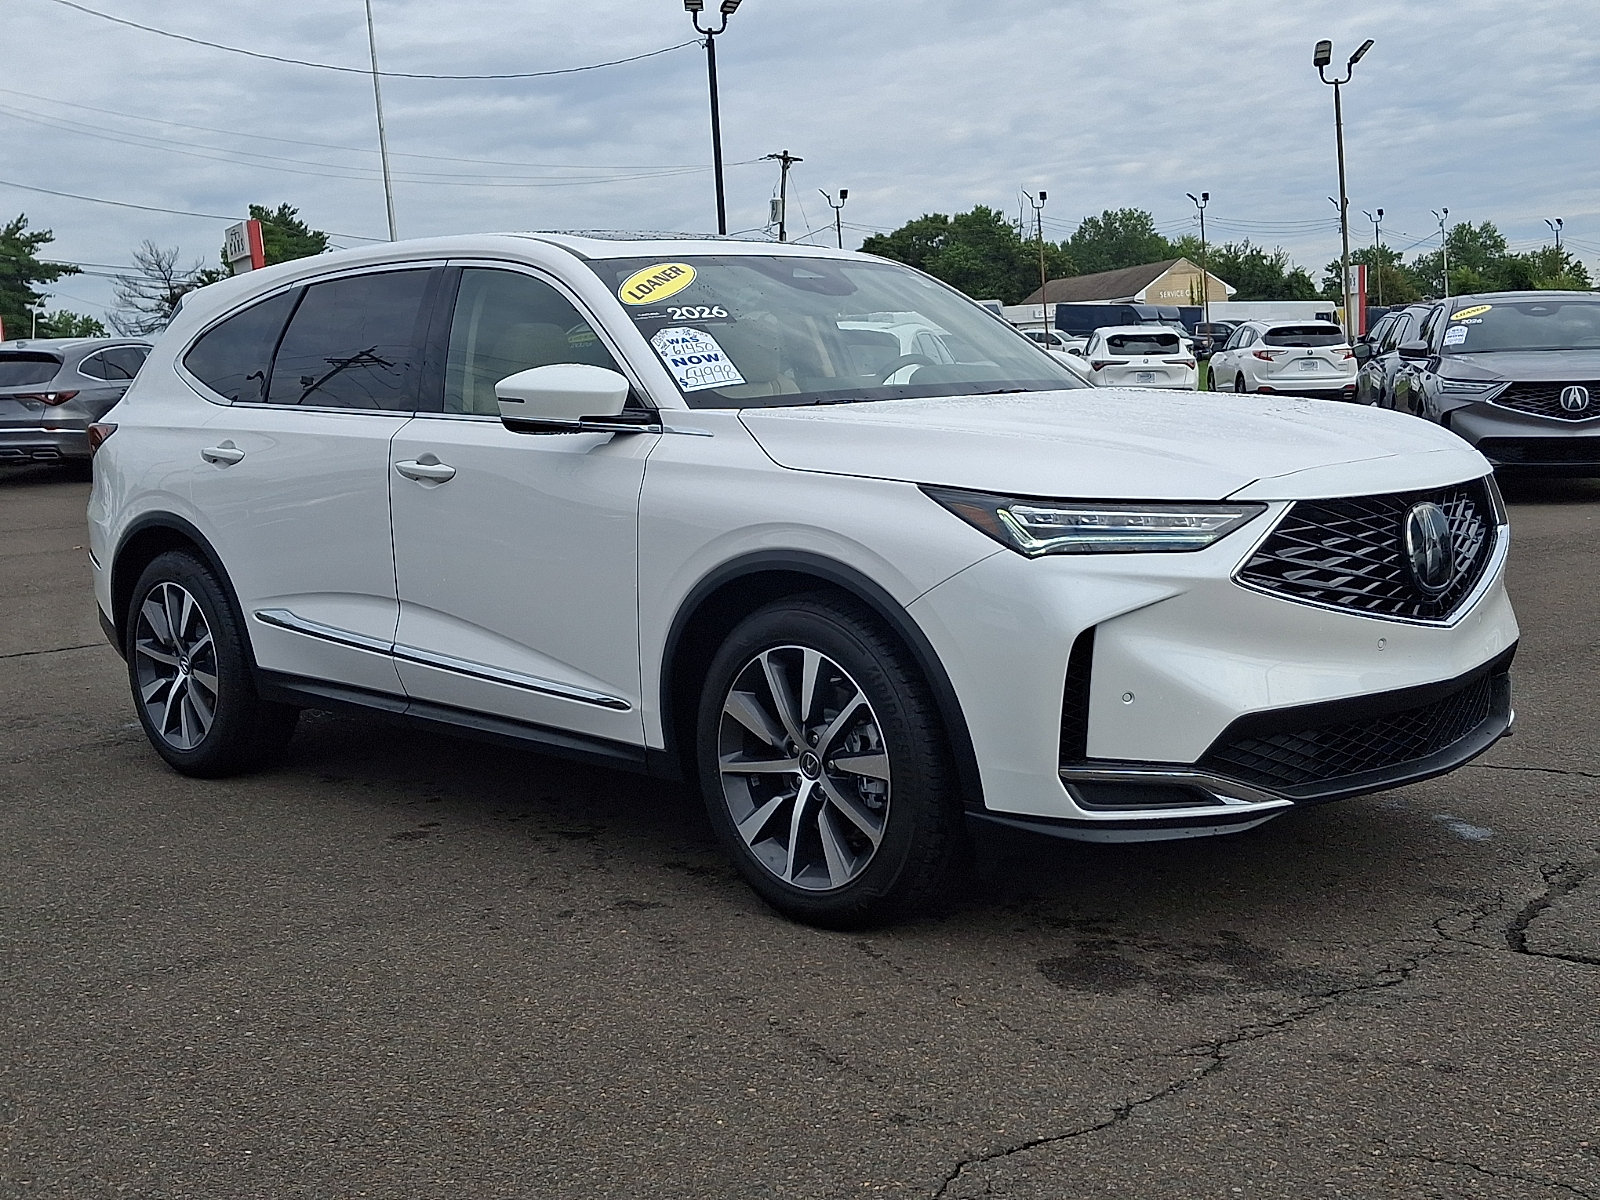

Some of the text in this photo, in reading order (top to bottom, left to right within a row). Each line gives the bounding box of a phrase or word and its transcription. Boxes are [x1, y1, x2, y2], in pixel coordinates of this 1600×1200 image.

[627, 265, 686, 301] LOANER
[1159, 289, 1184, 298] SERVICE
[666, 306, 728, 320] 2026
[665, 336, 700, 345] WAS
[670, 353, 720, 367] NOW
